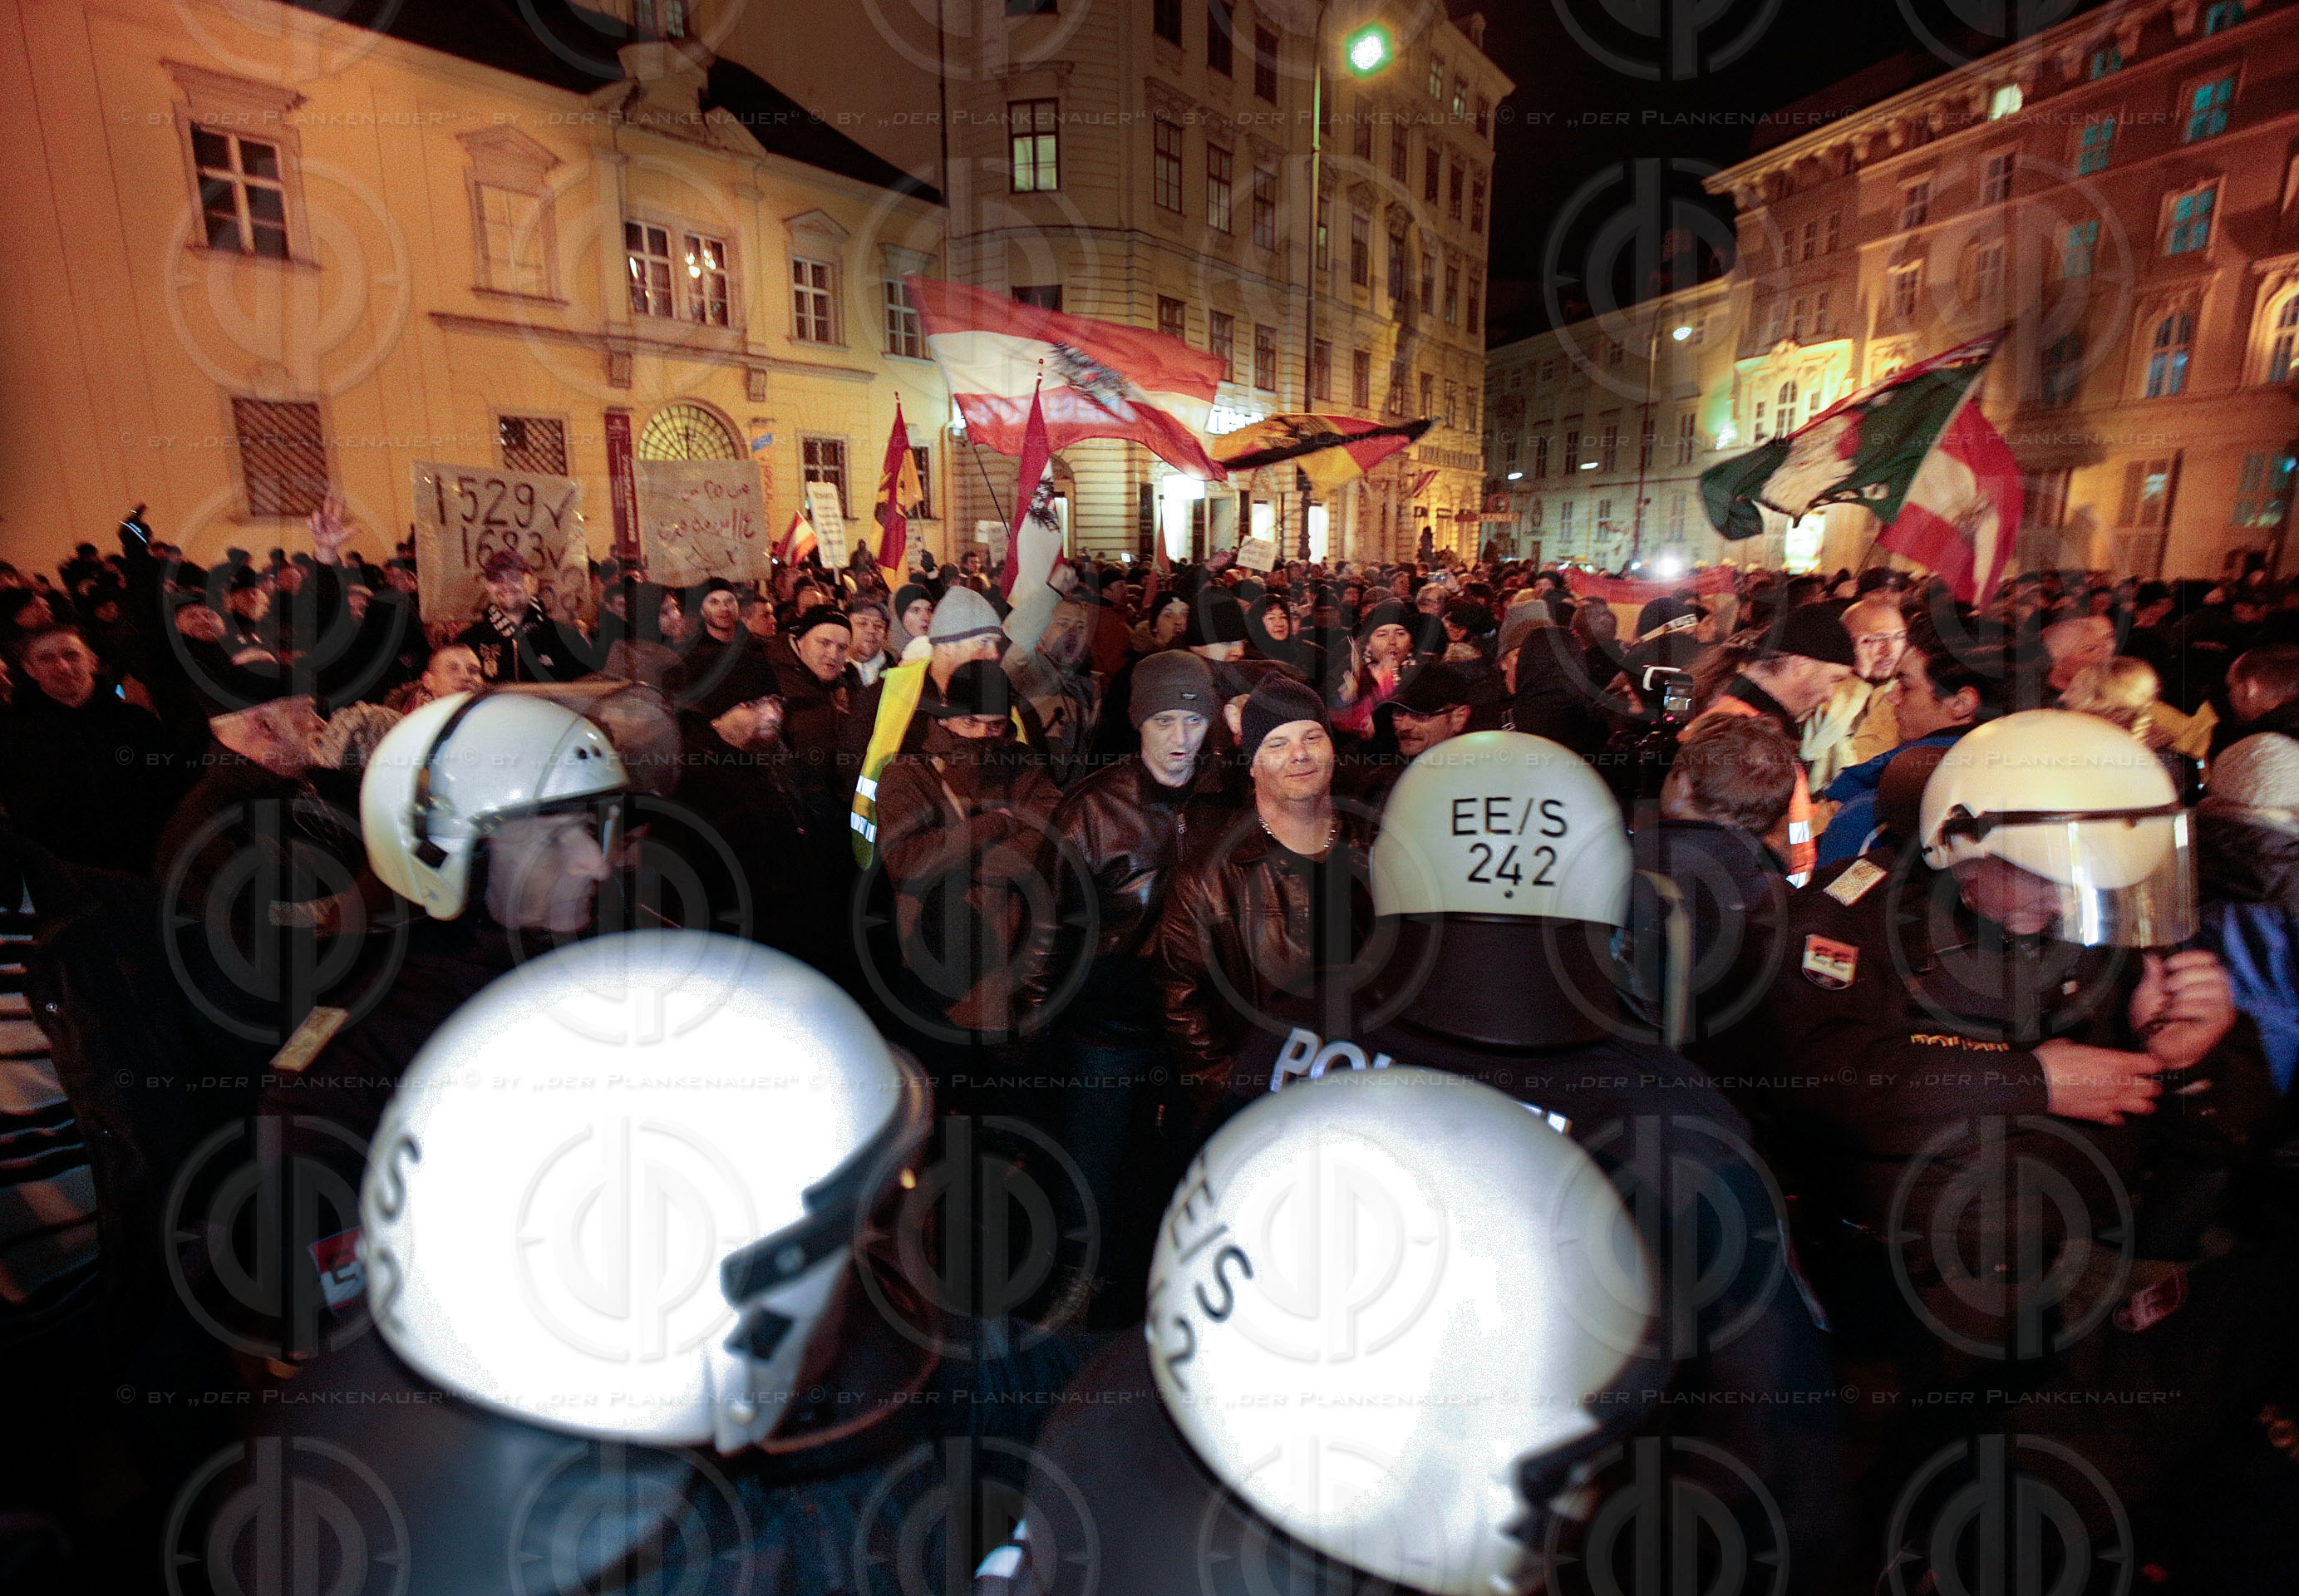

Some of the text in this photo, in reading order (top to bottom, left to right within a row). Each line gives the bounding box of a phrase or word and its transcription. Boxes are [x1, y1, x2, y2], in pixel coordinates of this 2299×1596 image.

[435, 474, 535, 528] 1529
[1452, 796, 1568, 838] EE/S
[1468, 842, 1557, 886] 242
